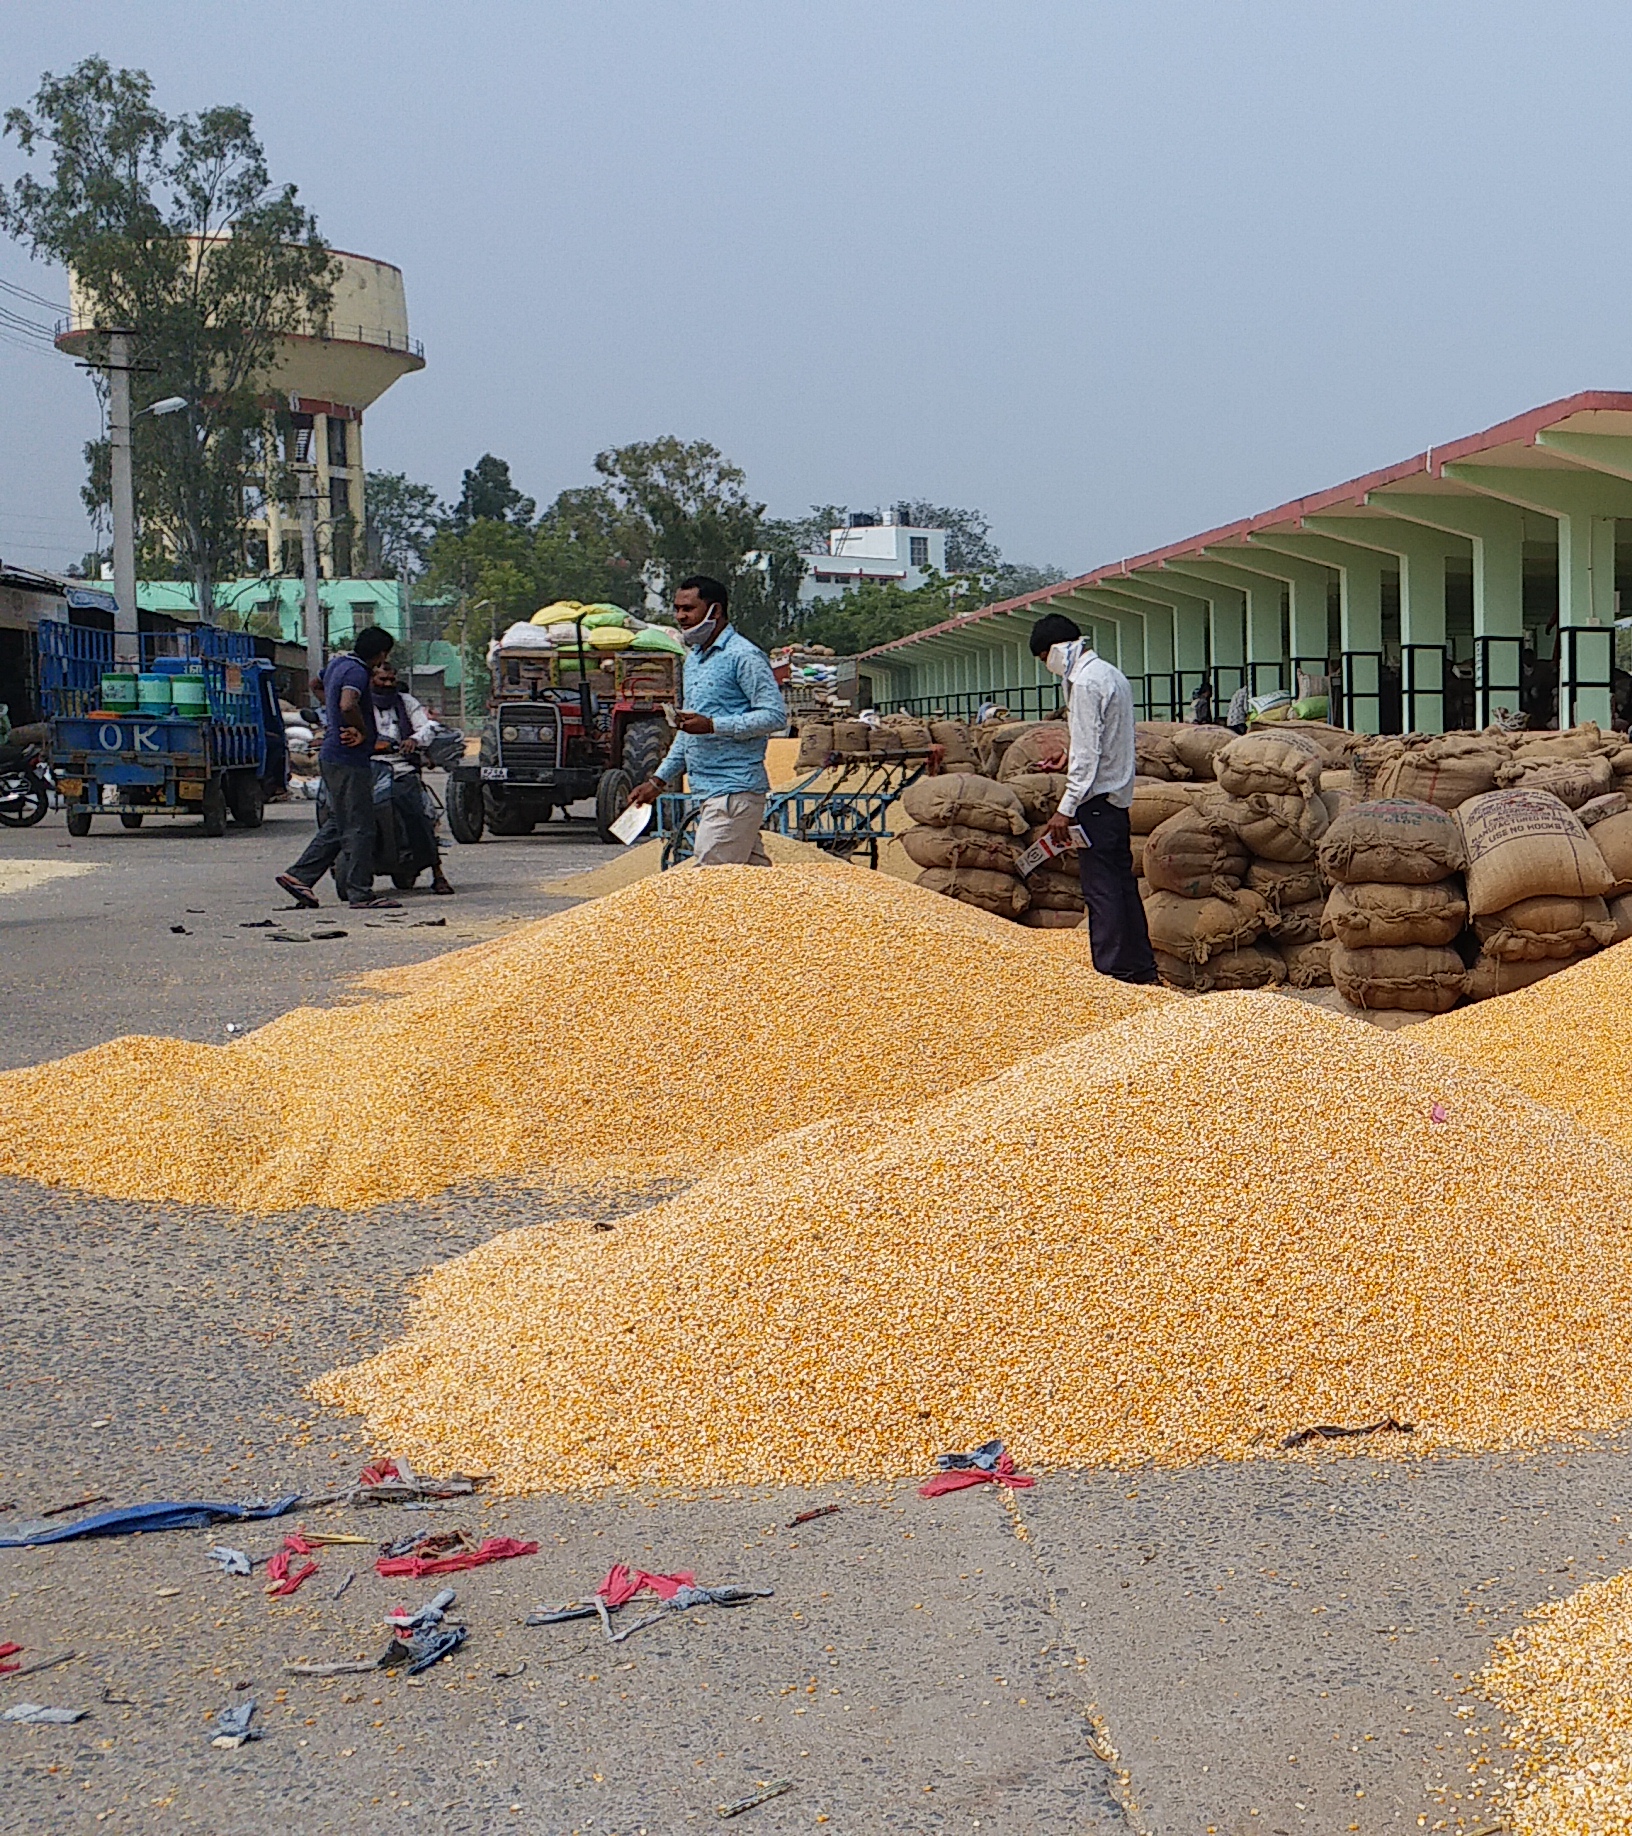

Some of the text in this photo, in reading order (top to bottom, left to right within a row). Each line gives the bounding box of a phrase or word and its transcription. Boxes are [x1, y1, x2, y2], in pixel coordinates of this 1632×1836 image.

[1471, 815, 1540, 845] MANUFACTURED
[1488, 822, 1562, 843] USE NO HOOKS
